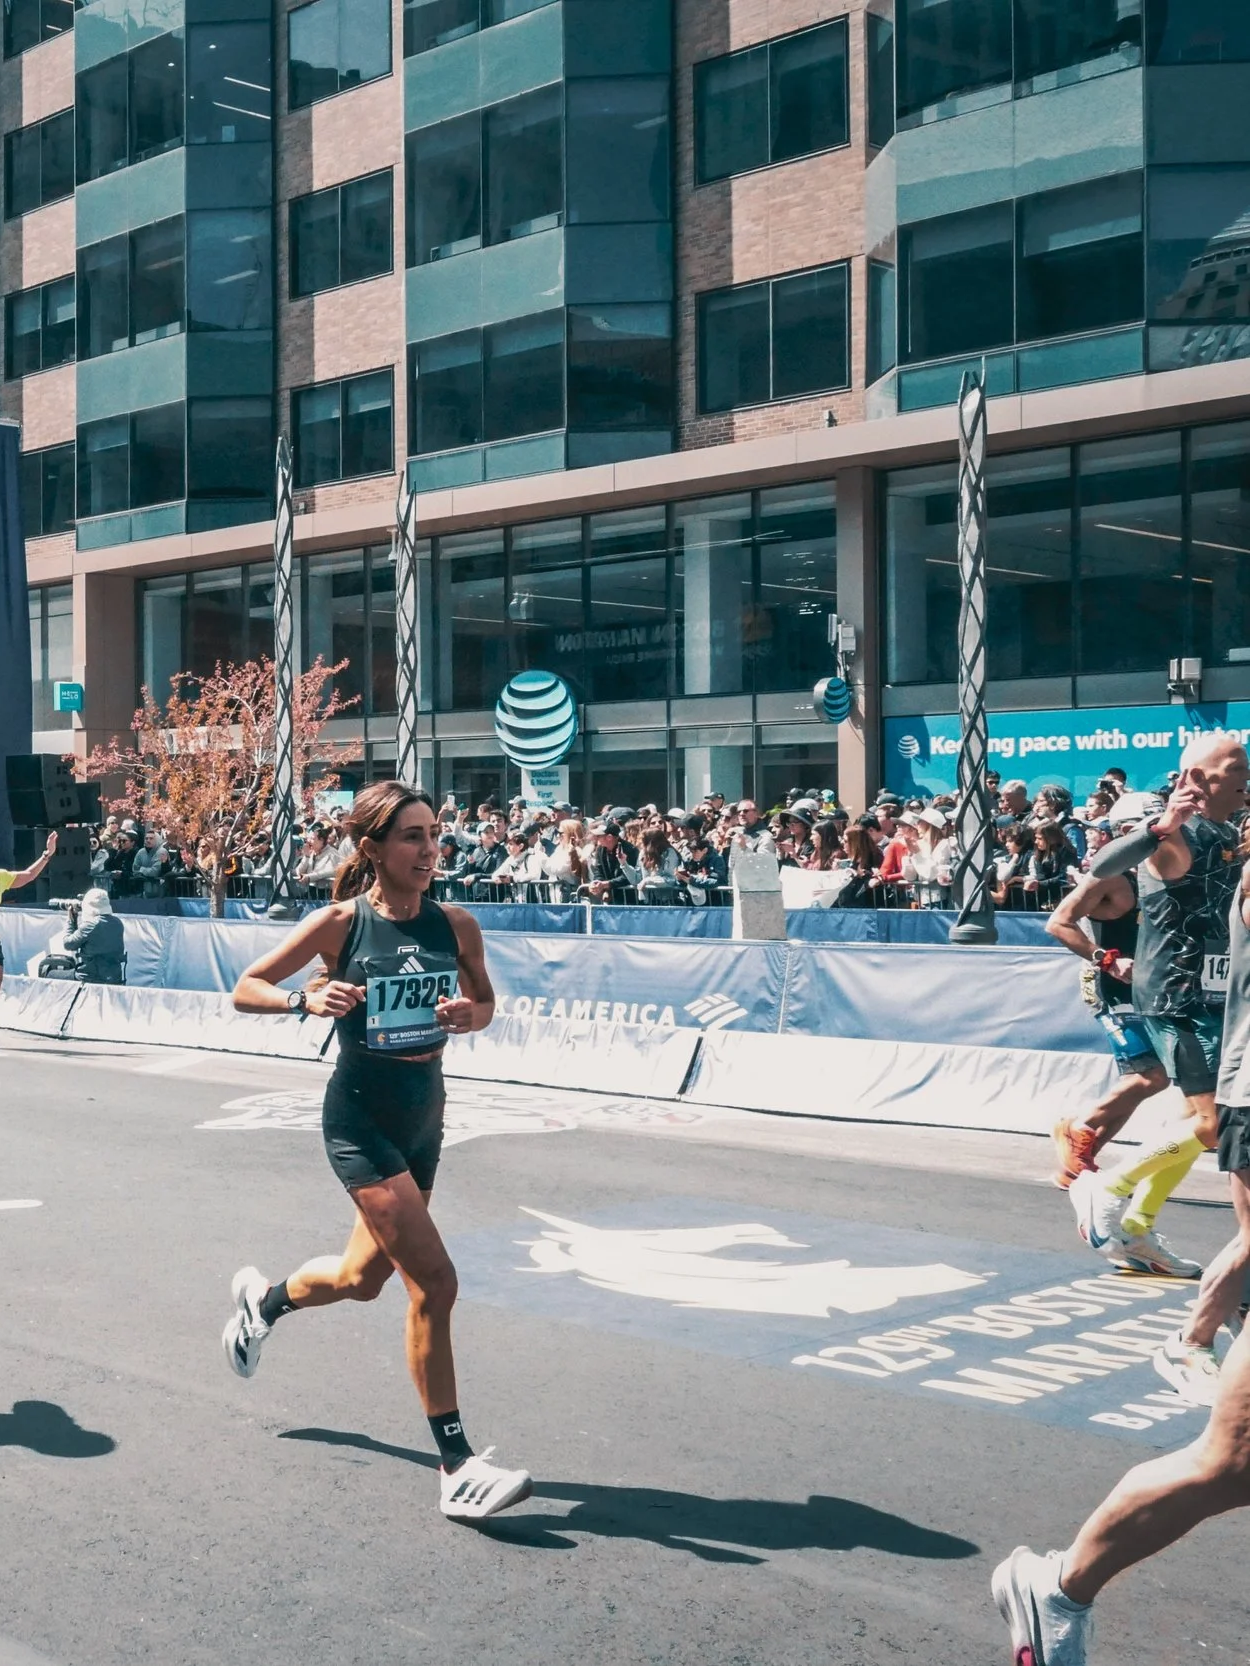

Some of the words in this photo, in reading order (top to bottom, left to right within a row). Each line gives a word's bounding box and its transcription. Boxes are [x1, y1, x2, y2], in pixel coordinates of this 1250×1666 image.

[930, 735, 1015, 758] Keng
[1019, 735, 1071, 757] pace
[1075, 728, 1128, 750] with
[1132, 731, 1174, 748] our
[1208, 957, 1230, 979] 147
[375, 975, 451, 1012] 17326
[513, 996, 546, 1020] OF
[551, 998, 677, 1028] AMERICA
[928, 1268, 1202, 1339] BOSTON
[919, 1299, 1200, 1405] MARATH
